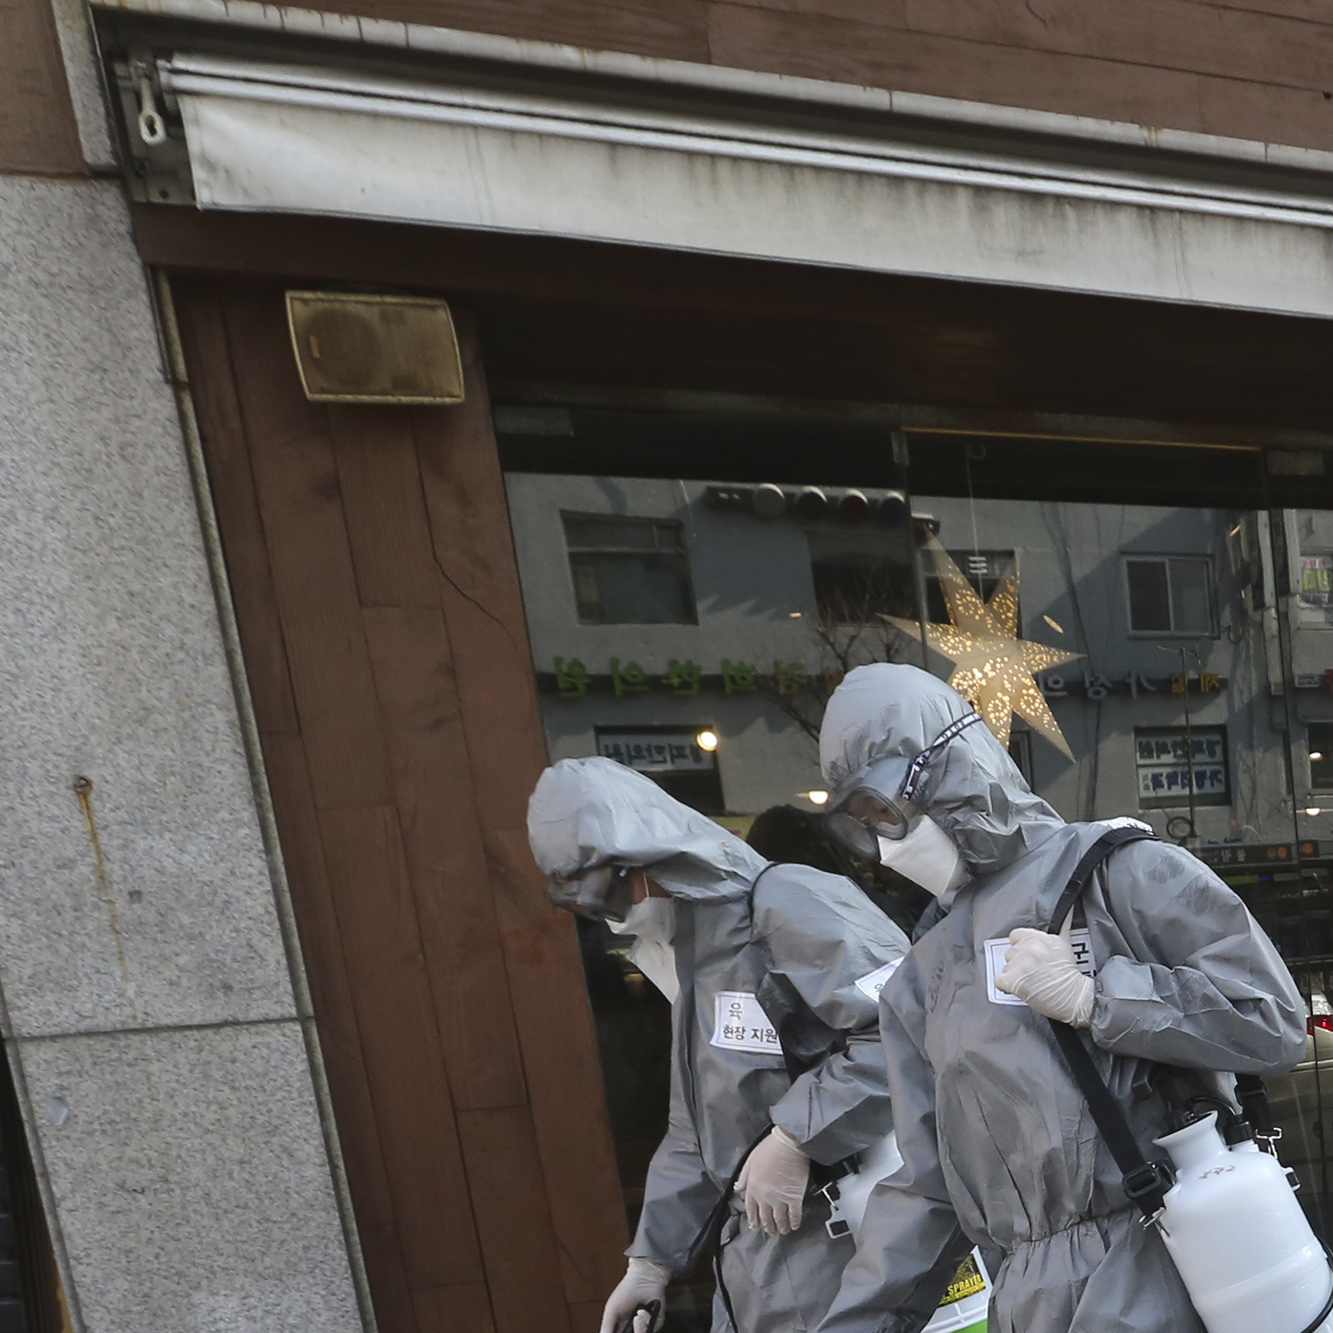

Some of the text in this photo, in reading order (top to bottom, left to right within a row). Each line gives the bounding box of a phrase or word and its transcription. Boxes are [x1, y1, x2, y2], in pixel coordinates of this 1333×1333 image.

[728, 1002, 743, 1020] 육
[723, 1024, 778, 1044] 현장 지원
